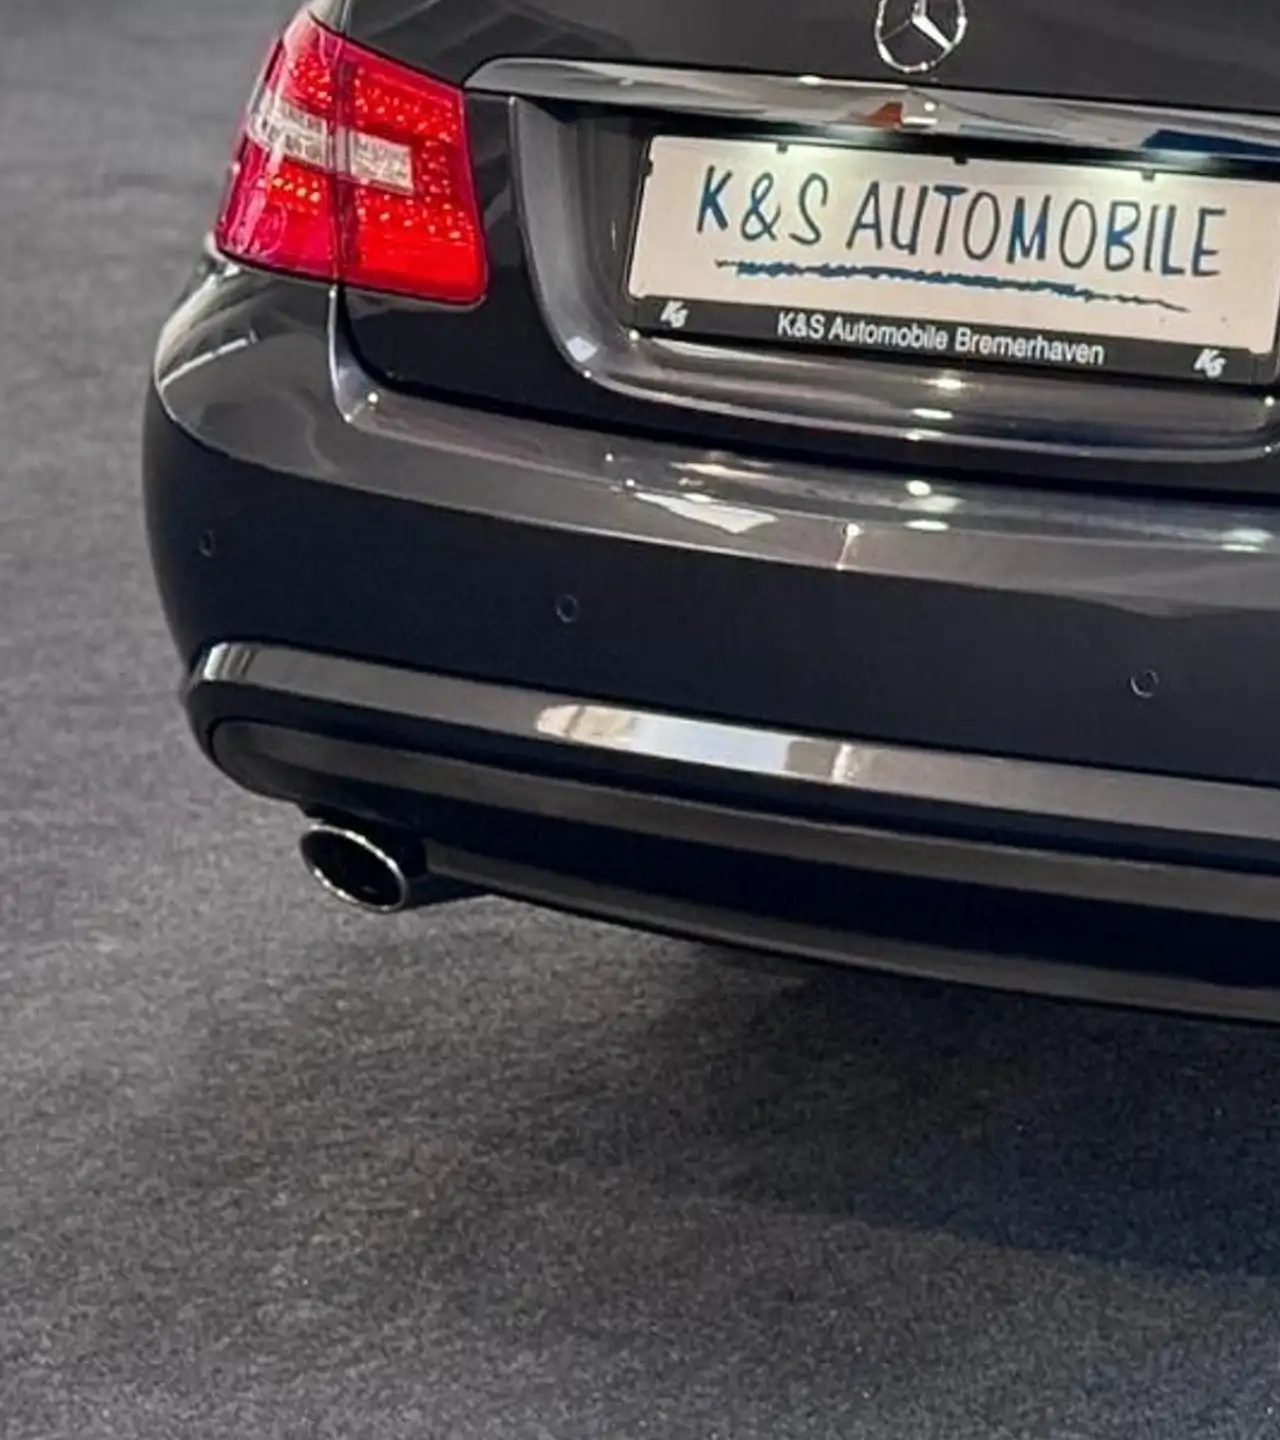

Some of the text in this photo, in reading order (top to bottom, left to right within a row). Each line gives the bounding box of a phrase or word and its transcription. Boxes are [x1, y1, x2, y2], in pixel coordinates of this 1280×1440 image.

[696, 165, 1227, 278] K&S AUTOMOBILE
[777, 312, 1105, 366] K&S Automobile Bremerhaven
